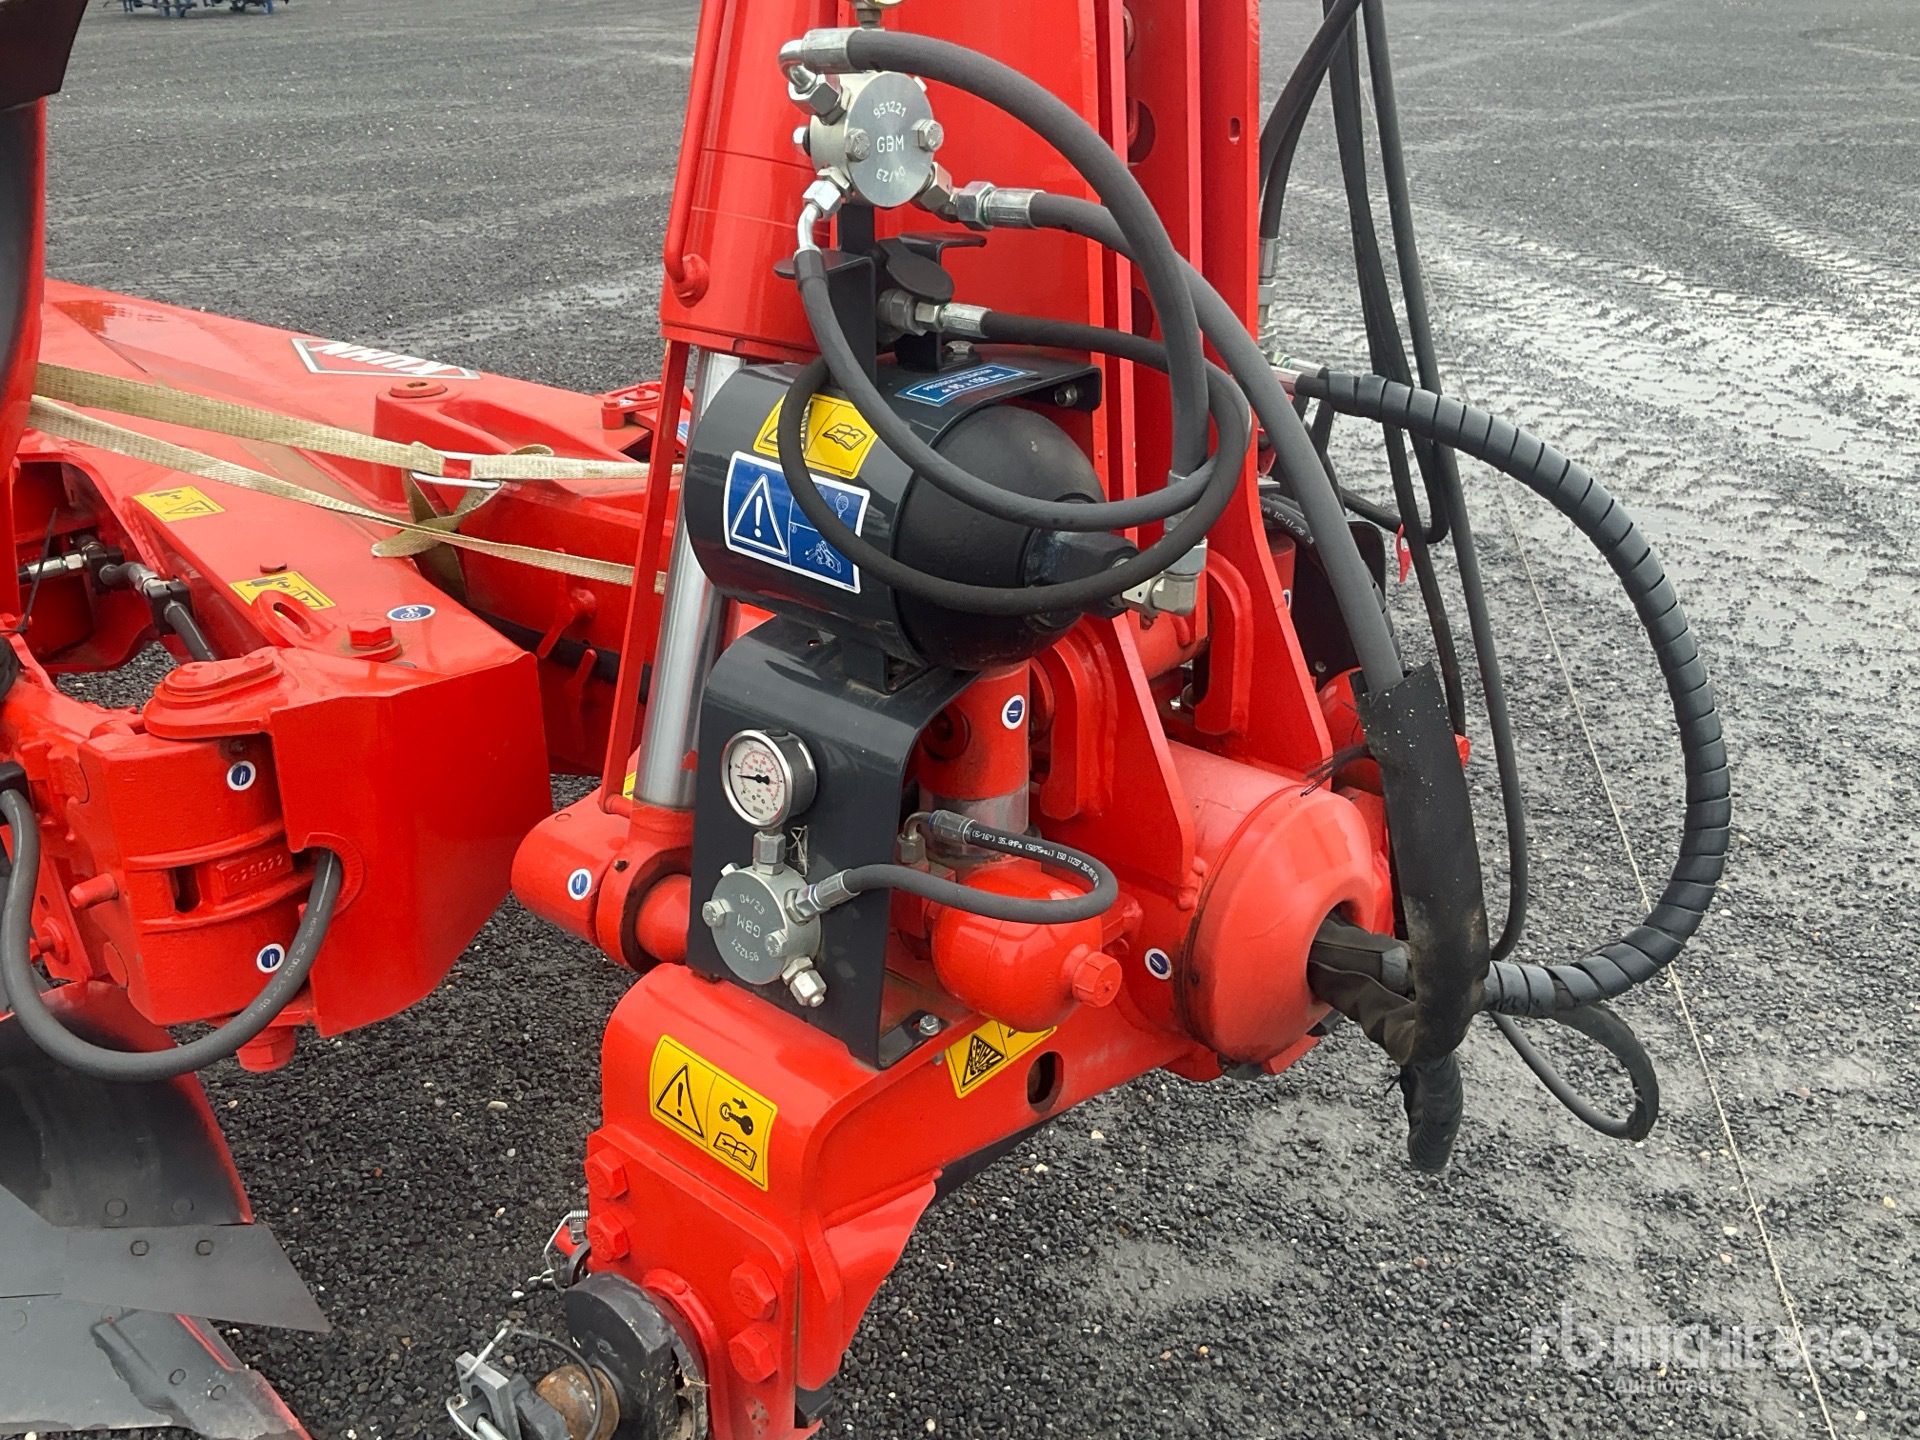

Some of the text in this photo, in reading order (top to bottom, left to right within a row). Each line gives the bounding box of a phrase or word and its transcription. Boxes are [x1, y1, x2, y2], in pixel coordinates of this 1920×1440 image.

[873, 101, 907, 118] 951221
[876, 135, 904, 153] GBM
[308, 341, 458, 375] KUHN
[1057, 851, 1067, 861] ISO
[739, 893, 765, 915] 04/23
[736, 914, 761, 938] GBM
[731, 938, 759, 961] 951221
